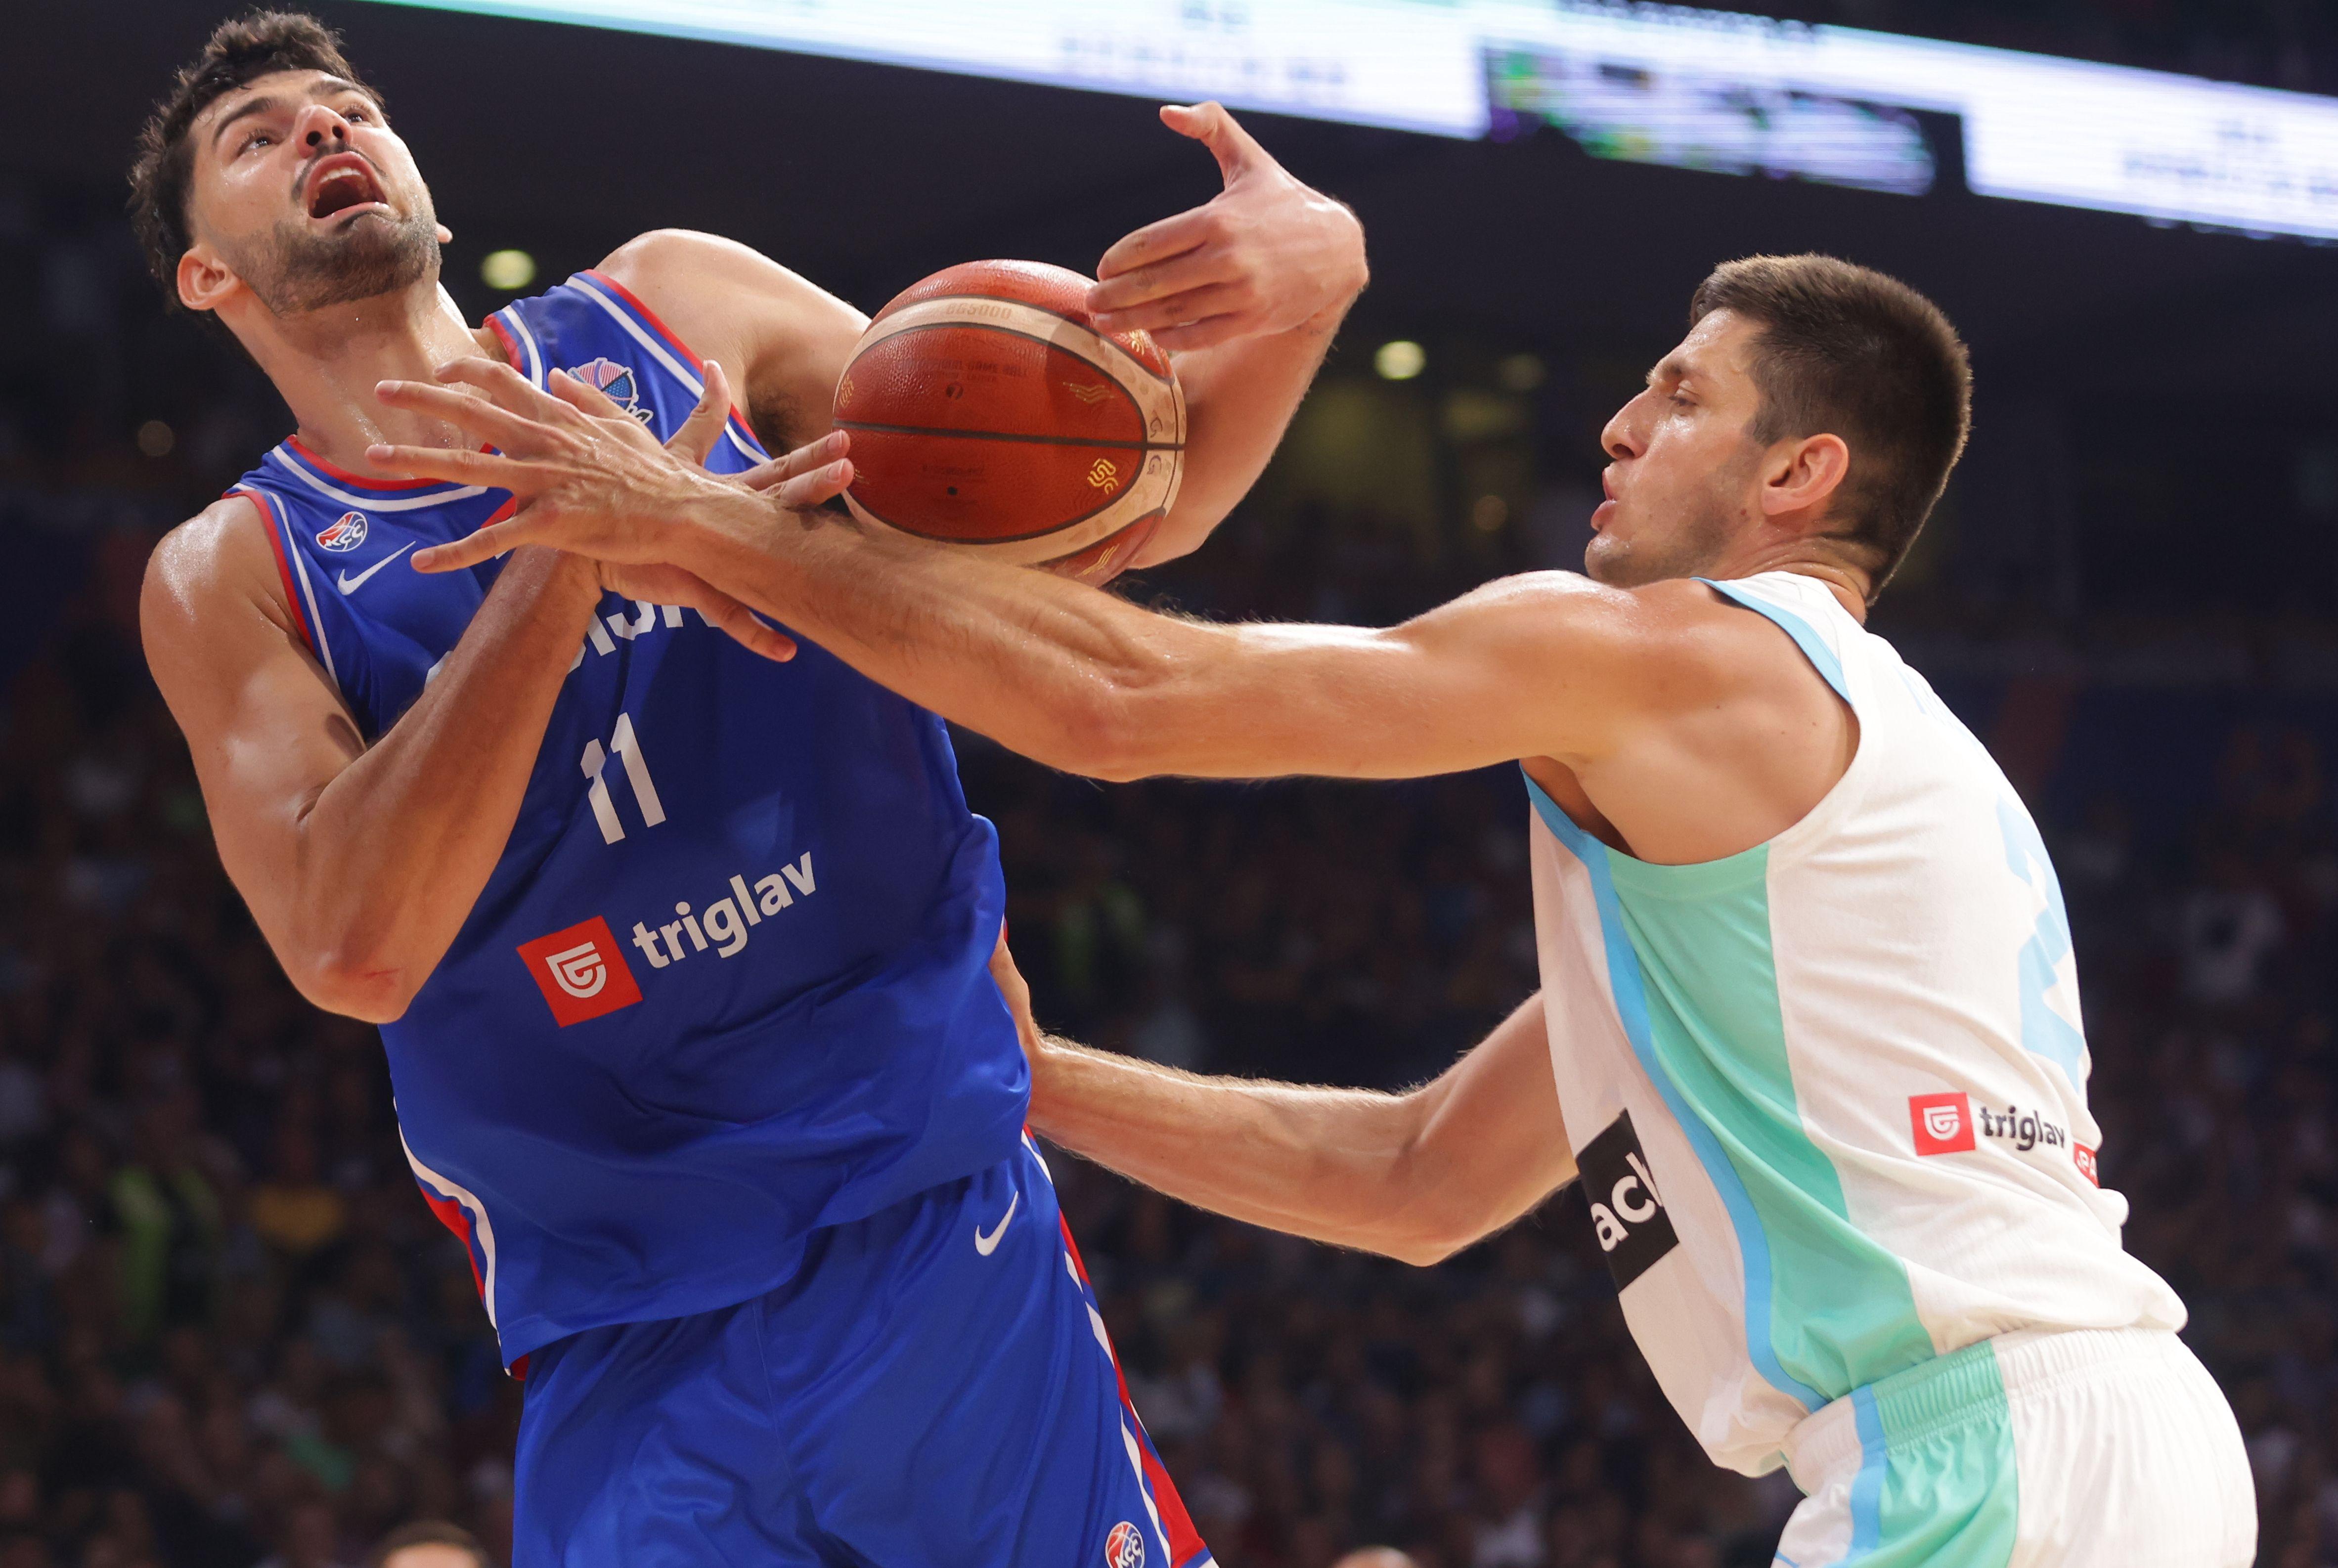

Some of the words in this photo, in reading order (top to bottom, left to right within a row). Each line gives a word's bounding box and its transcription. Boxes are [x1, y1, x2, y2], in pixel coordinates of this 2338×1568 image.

[580, 712, 666, 844] 11
[632, 851, 816, 969] triglav
[1980, 1105, 2065, 1151] triglav
